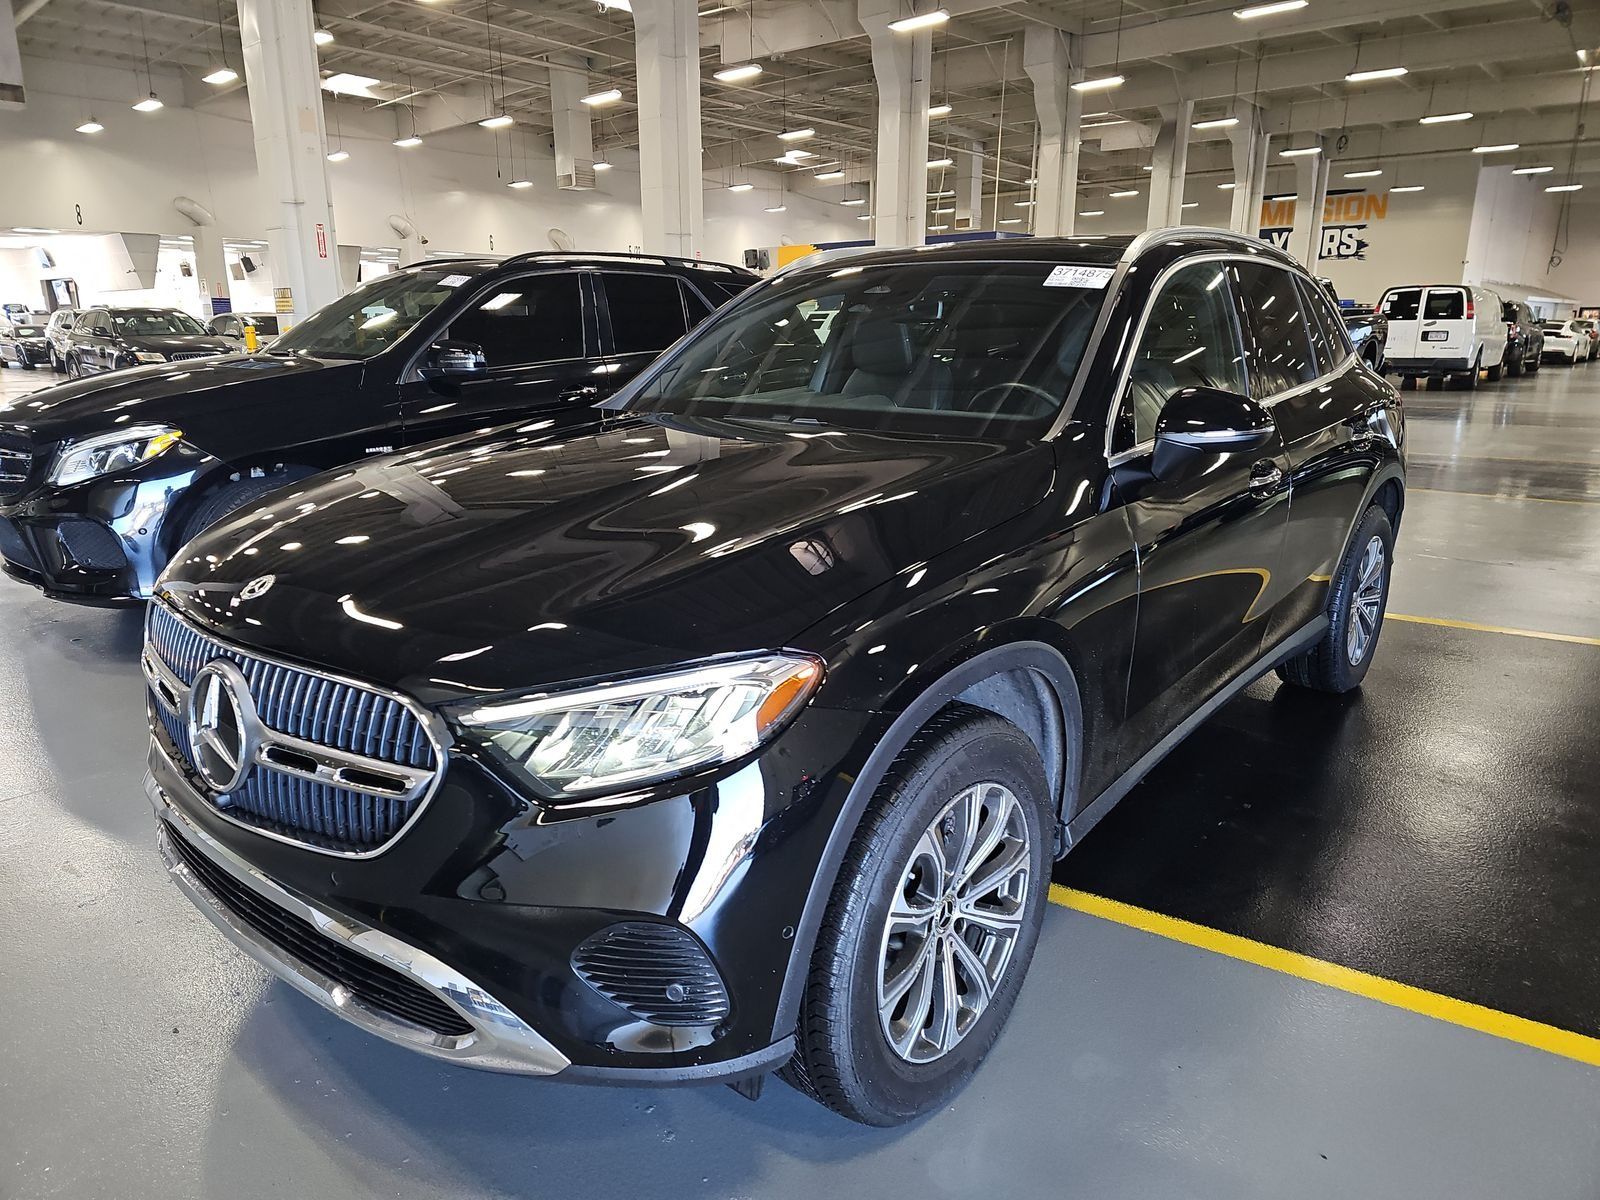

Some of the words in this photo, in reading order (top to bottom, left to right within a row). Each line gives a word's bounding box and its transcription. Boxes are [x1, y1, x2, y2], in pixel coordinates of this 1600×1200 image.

[75, 203, 83, 225] 8
[1260, 193, 1388, 227] MISION
[489, 234, 494, 251] 6
[1053, 268, 1112, 279] 3714875
